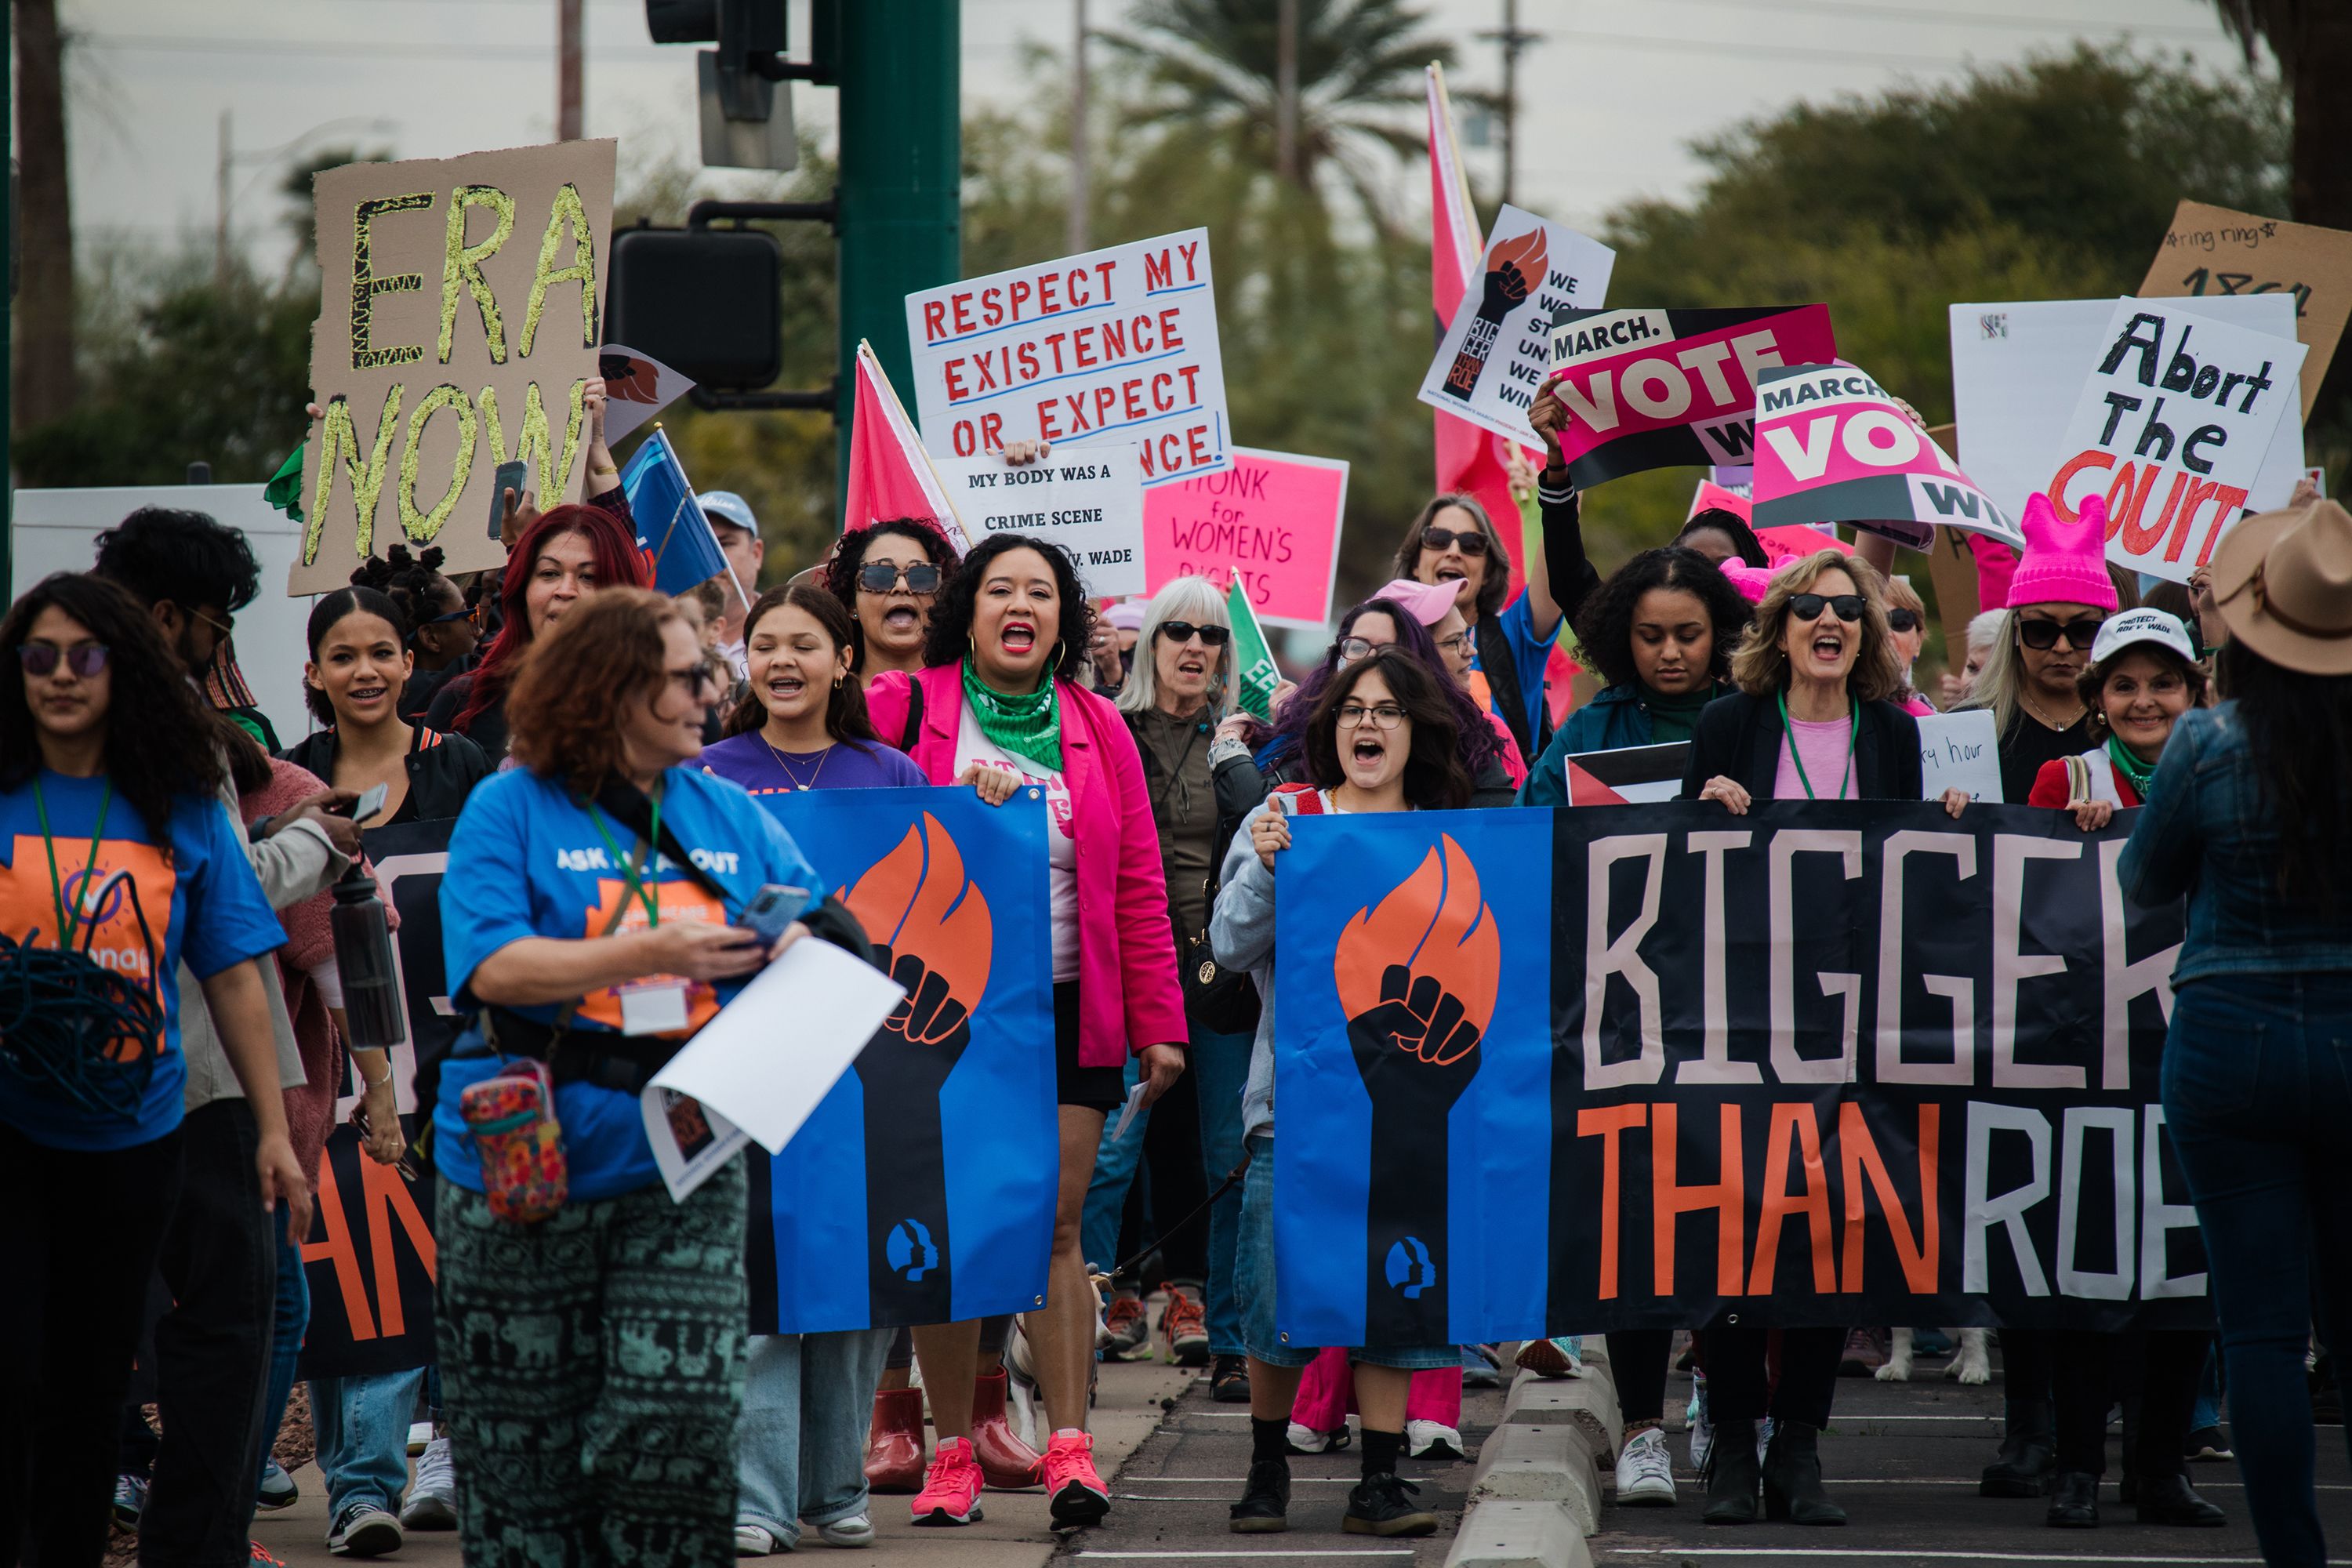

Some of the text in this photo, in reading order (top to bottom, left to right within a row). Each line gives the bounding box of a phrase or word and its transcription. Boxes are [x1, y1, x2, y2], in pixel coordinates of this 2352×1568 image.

[2180, 227, 2259, 252] ring ring
[350, 182, 598, 371] ERA
[1550, 270, 1578, 294] WE
[924, 241, 1199, 341] RESPECT MY
[1469, 317, 1501, 343] BIG
[1555, 315, 1661, 361] MARCH.
[945, 308, 1184, 401] EXISTENCE
[2098, 313, 2273, 414] Abort
[1447, 363, 1479, 391] ROE
[1509, 360, 1541, 386] WE
[1553, 328, 1785, 433] VOTE
[953, 365, 1200, 457] OR EXPECT
[2098, 392, 2228, 474] The
[302, 378, 586, 566] NOW
[968, 464, 1111, 488] MY BODY WAS A
[985, 509, 1102, 531] CRIME SCENE
[1212, 501, 1244, 523] for
[1173, 517, 1292, 563] WOMEN'S
[1088, 549, 1132, 565] WADE
[2118, 615, 2158, 626] PROTECT
[2147, 623, 2171, 633] WADE
[1946, 736, 1982, 763] hour
[557, 848, 610, 872] ASK
[655, 848, 739, 875] AOUT
[1577, 1101, 2209, 1301] THAN ROE
